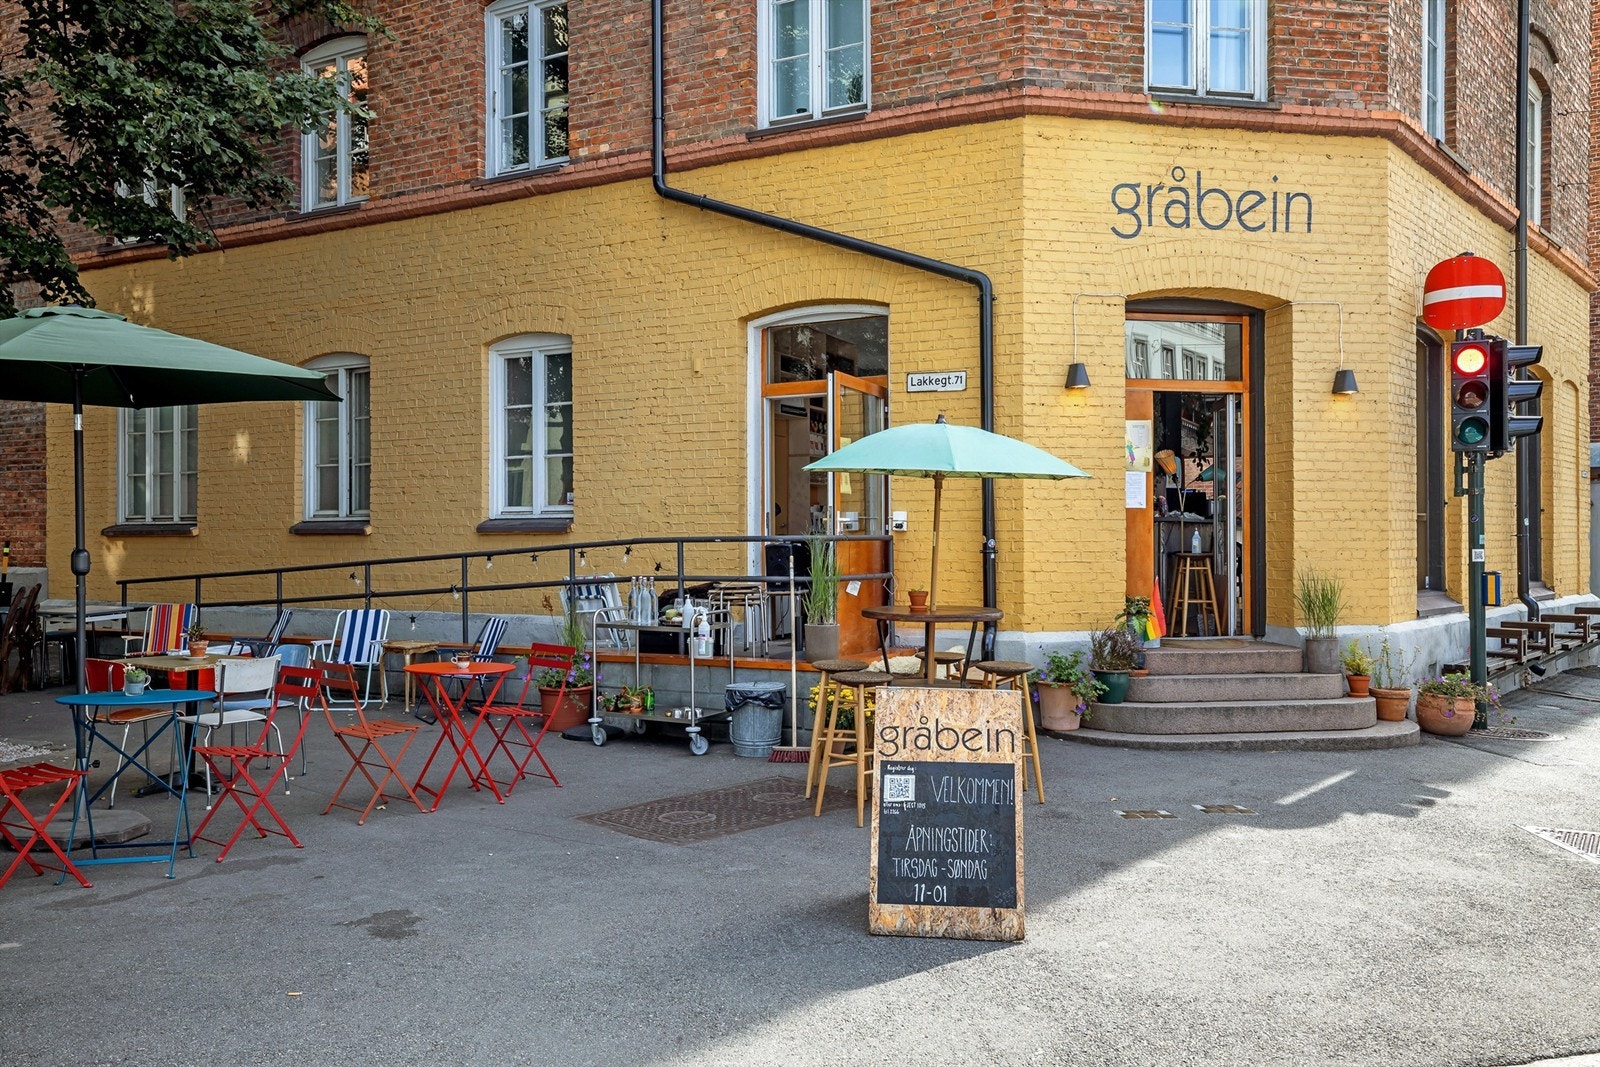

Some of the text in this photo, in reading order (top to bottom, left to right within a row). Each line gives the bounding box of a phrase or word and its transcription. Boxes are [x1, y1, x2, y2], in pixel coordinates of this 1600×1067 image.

[1110, 166, 1312, 239] gråbein
[878, 716, 1015, 757] gråbein
[930, 775, 1014, 806] VELKOMMEN!
[905, 824, 993, 853] ÅPNINGSTIDER:
[914, 883, 947, 902] 11-01
